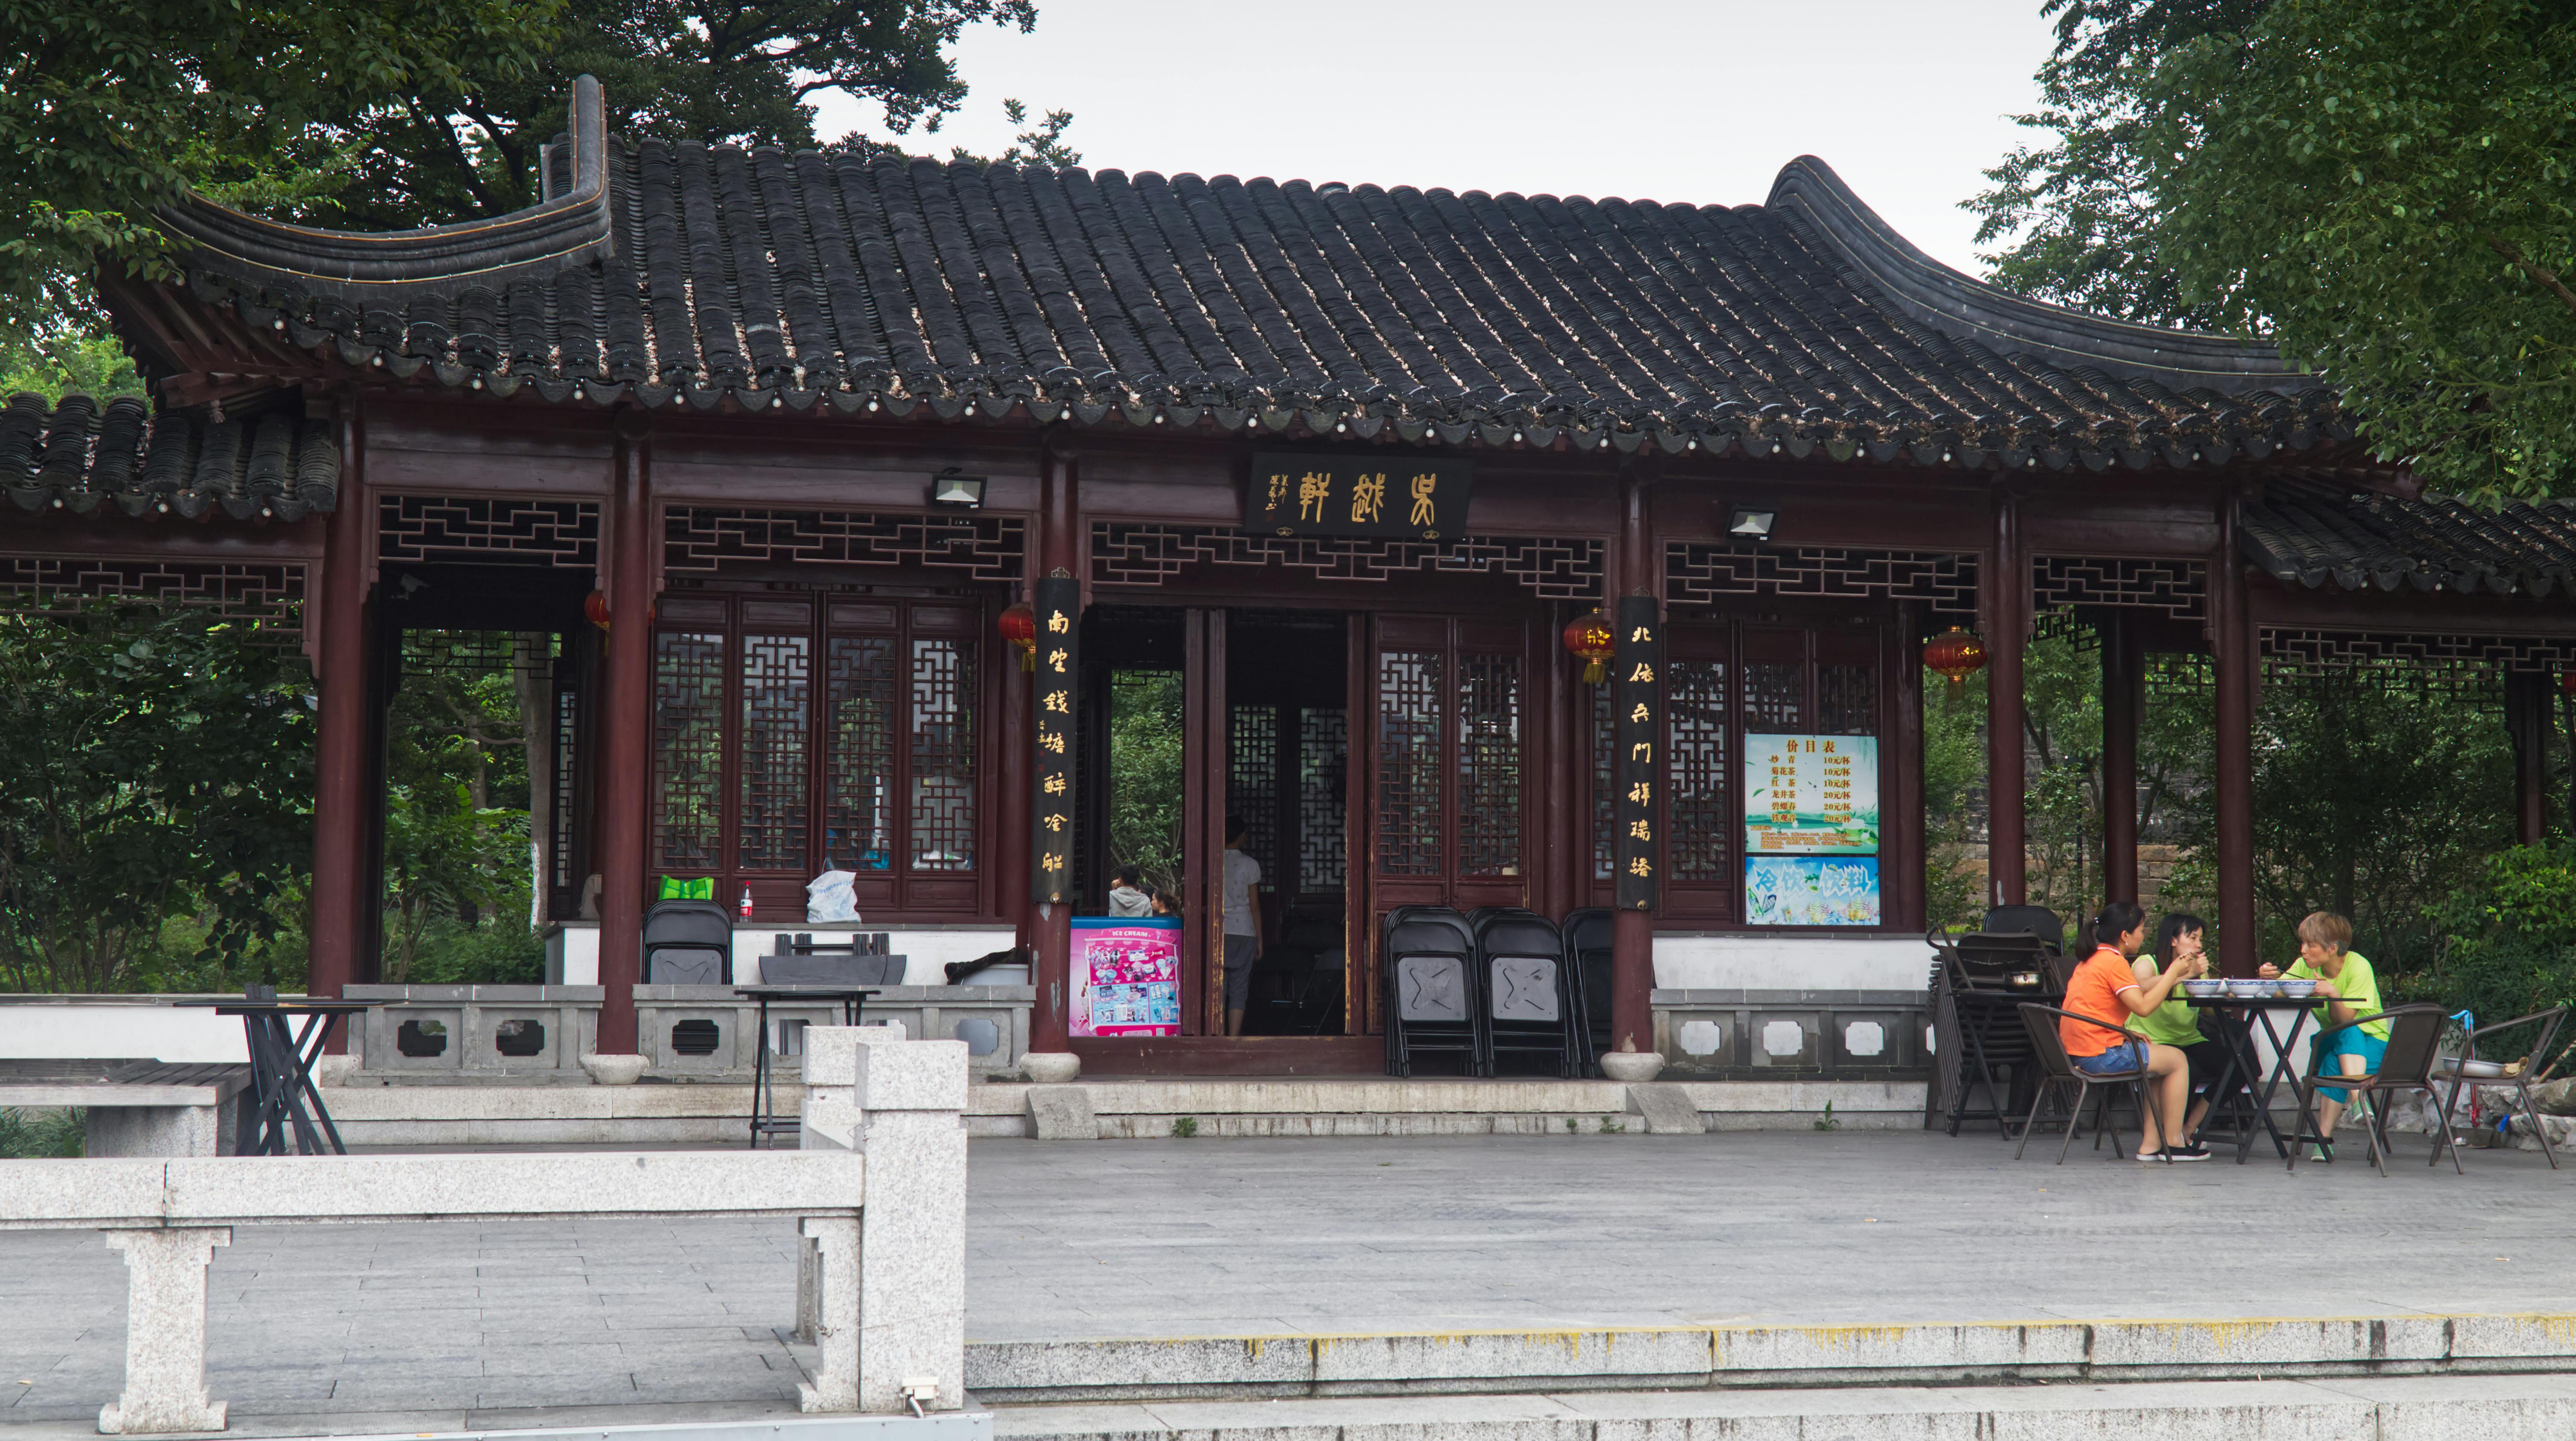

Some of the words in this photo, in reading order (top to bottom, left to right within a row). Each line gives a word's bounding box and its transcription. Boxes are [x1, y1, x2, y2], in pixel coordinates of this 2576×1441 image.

[1786, 740, 1835, 753] 价目表
[1771, 755, 1795, 764] 炒青
[1823, 756, 1850, 765] 10元/杯
[1771, 767, 1795, 775] 菊花茶
[1823, 768, 1850, 776] 10元/杯
[1771, 779, 1795, 787] 红茶
[1824, 780, 1850, 788] 10元/杯
[1771, 790, 1795, 798] 龙井茶
[1823, 791, 1850, 800] 20元/杯
[1772, 802, 1796, 810] 碧螺春
[1824, 803, 1851, 811] 20元/杯
[1772, 813, 1796, 822] 铁观音
[1824, 815, 1851, 823] 20元/杯
[1753, 863, 1808, 898] 冷饮
[1819, 863, 1872, 898] 饮料
